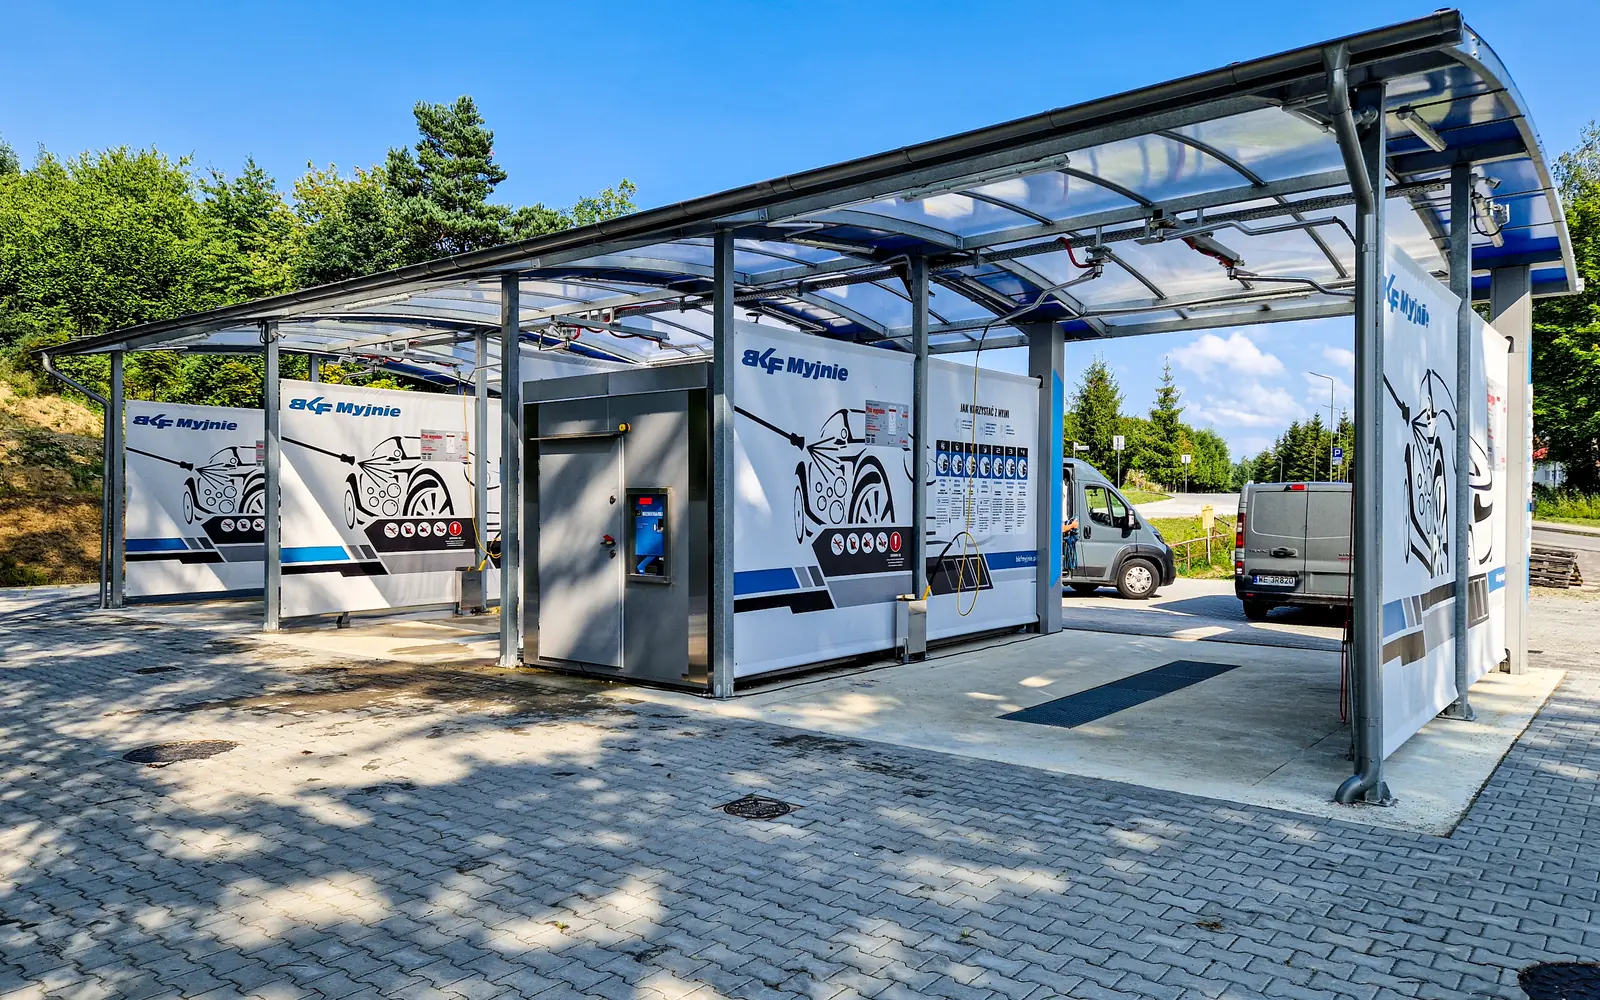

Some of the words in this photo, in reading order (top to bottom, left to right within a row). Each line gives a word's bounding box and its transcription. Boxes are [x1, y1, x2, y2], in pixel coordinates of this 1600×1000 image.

[1384, 274, 1399, 313] KF
[742, 347, 784, 375] BKF
[786, 356, 849, 381] Myjnie
[288, 396, 333, 415] BKF
[336, 402, 402, 417] Myjnie
[960, 403, 969, 413] JAK
[970, 404, 994, 417] KRZYSTAĆ
[133, 413, 174, 429] BKF
[176, 418, 238, 431] Myjnie
[1258, 575, 1269, 584] WE
[1270, 575, 1294, 585] 3R820
